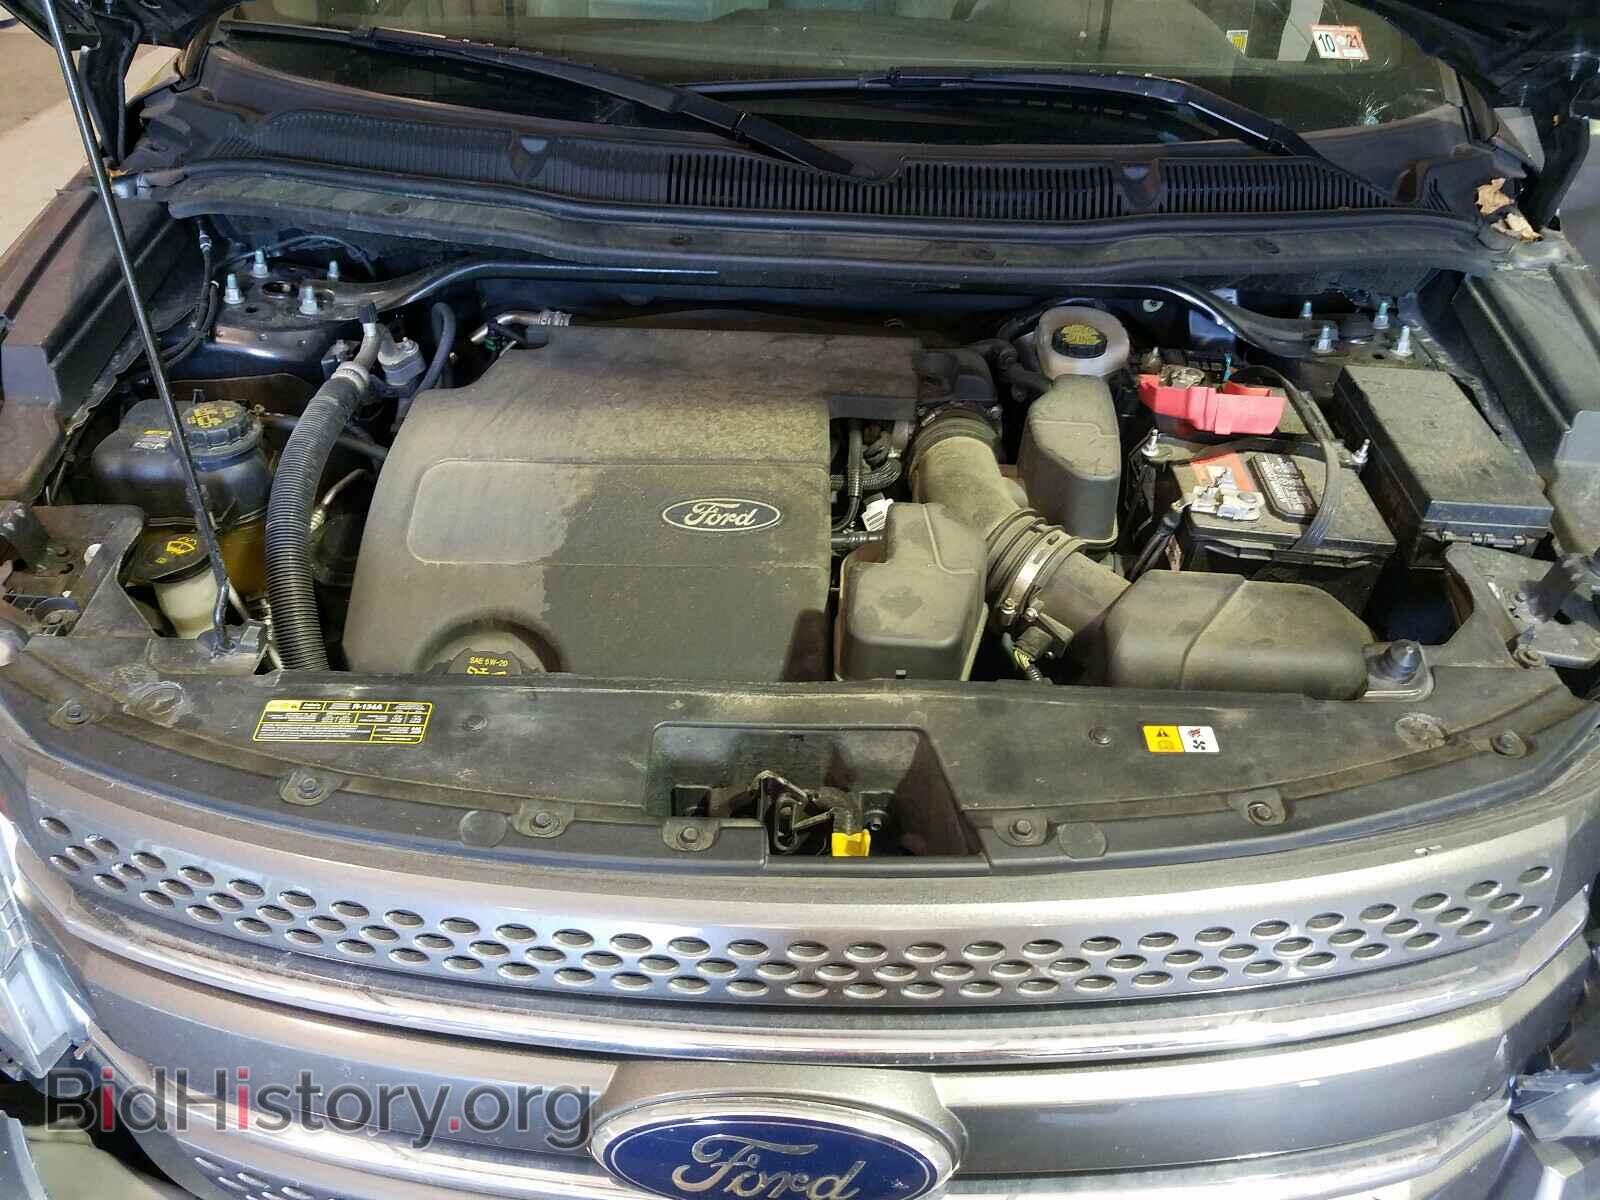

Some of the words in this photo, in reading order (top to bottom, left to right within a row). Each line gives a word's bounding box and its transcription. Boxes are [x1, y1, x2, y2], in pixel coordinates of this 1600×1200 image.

[1318, 33, 1336, 52] 10
[1345, 33, 1362, 48] 21
[684, 502, 758, 526] Ford
[469, 656, 484, 665] SAE
[485, 657, 509, 667] 5W-20
[671, 1134, 867, 1200] Ford
